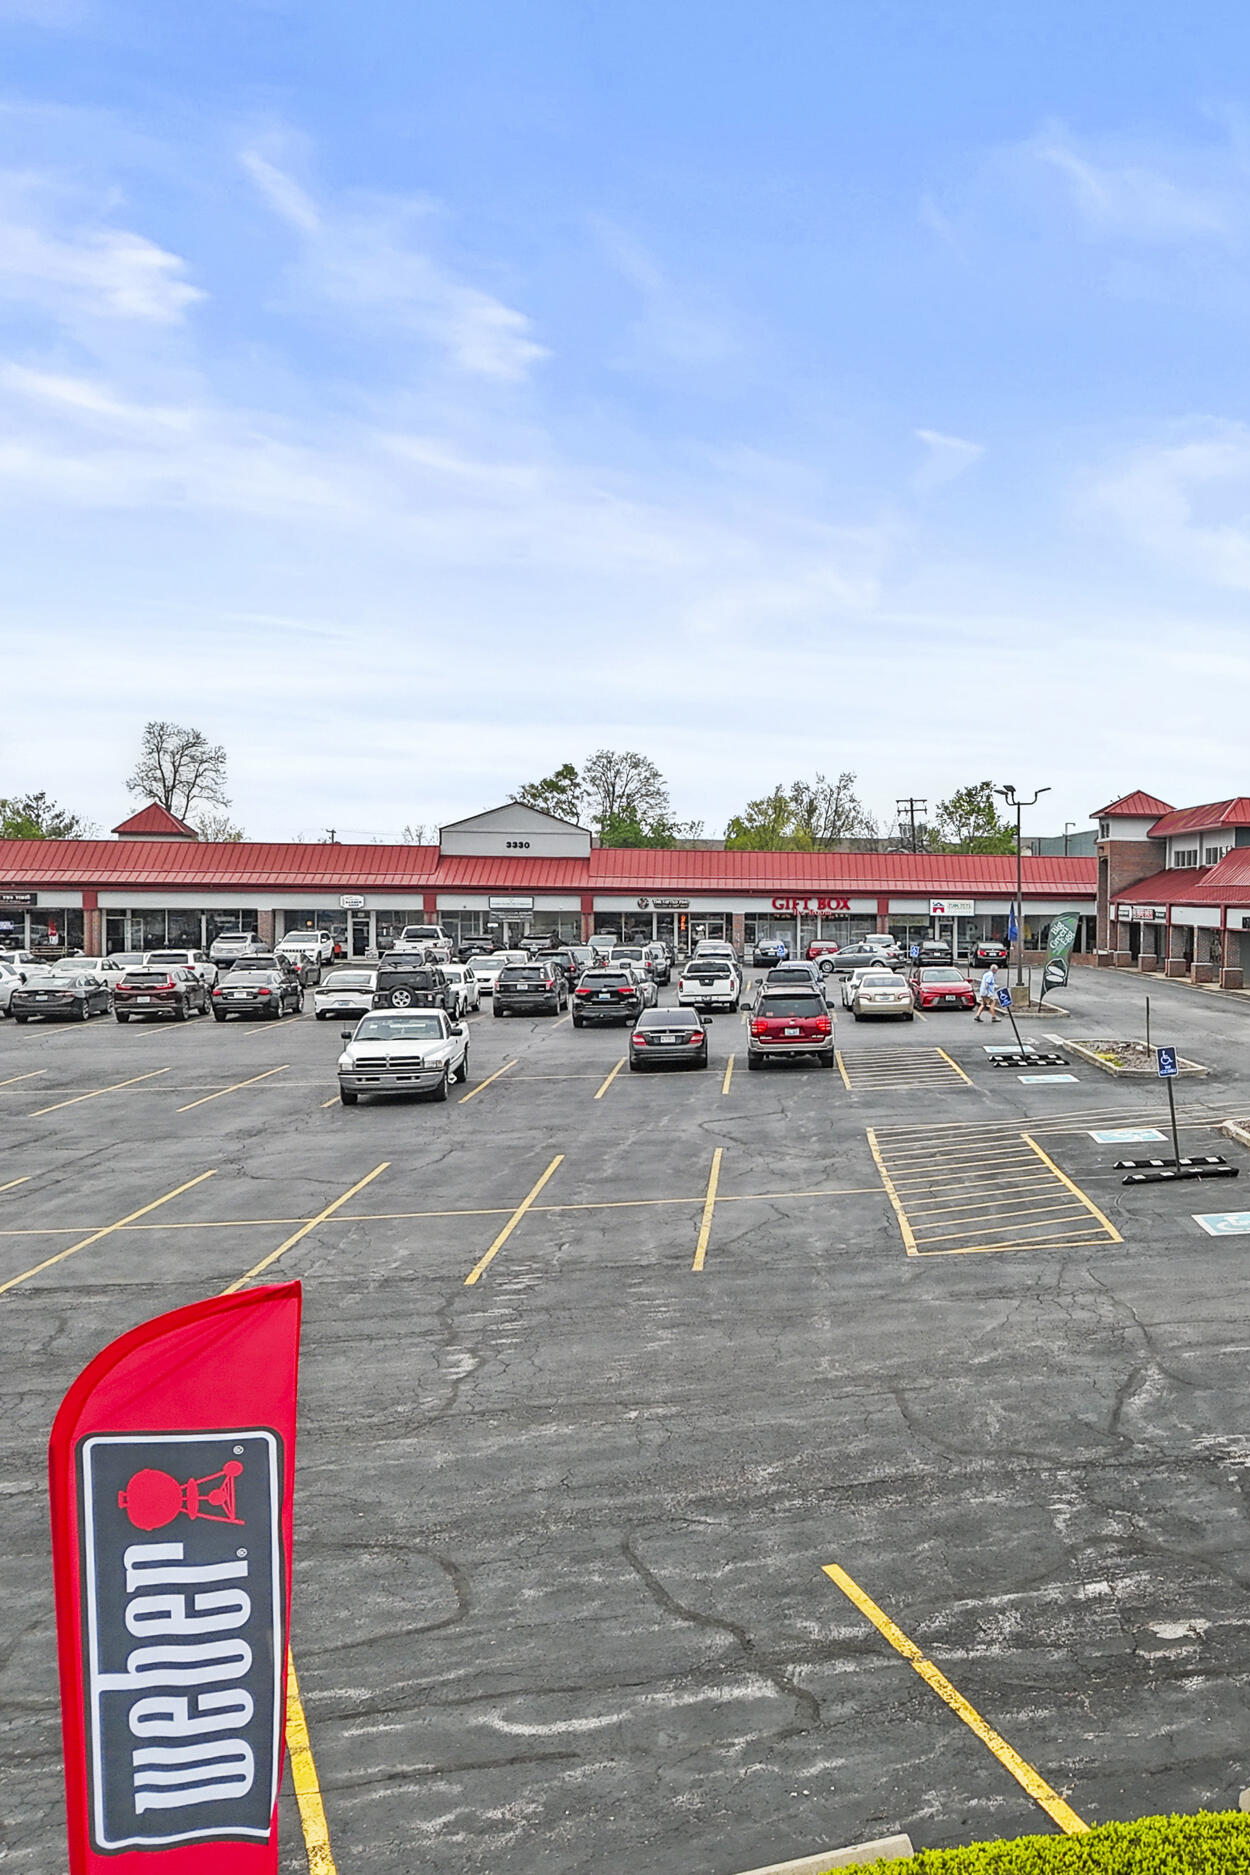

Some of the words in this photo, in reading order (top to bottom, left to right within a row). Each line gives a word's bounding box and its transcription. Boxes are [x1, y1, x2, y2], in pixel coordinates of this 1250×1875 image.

[506, 841, 530, 849] 3330
[772, 896, 812, 910] GIFT
[817, 896, 851, 910] BOX
[1050, 921, 1065, 936] Big
[1049, 926, 1069, 949] Green
[1060, 930, 1076, 946] Egg
[99, 1542, 255, 1816] weber
